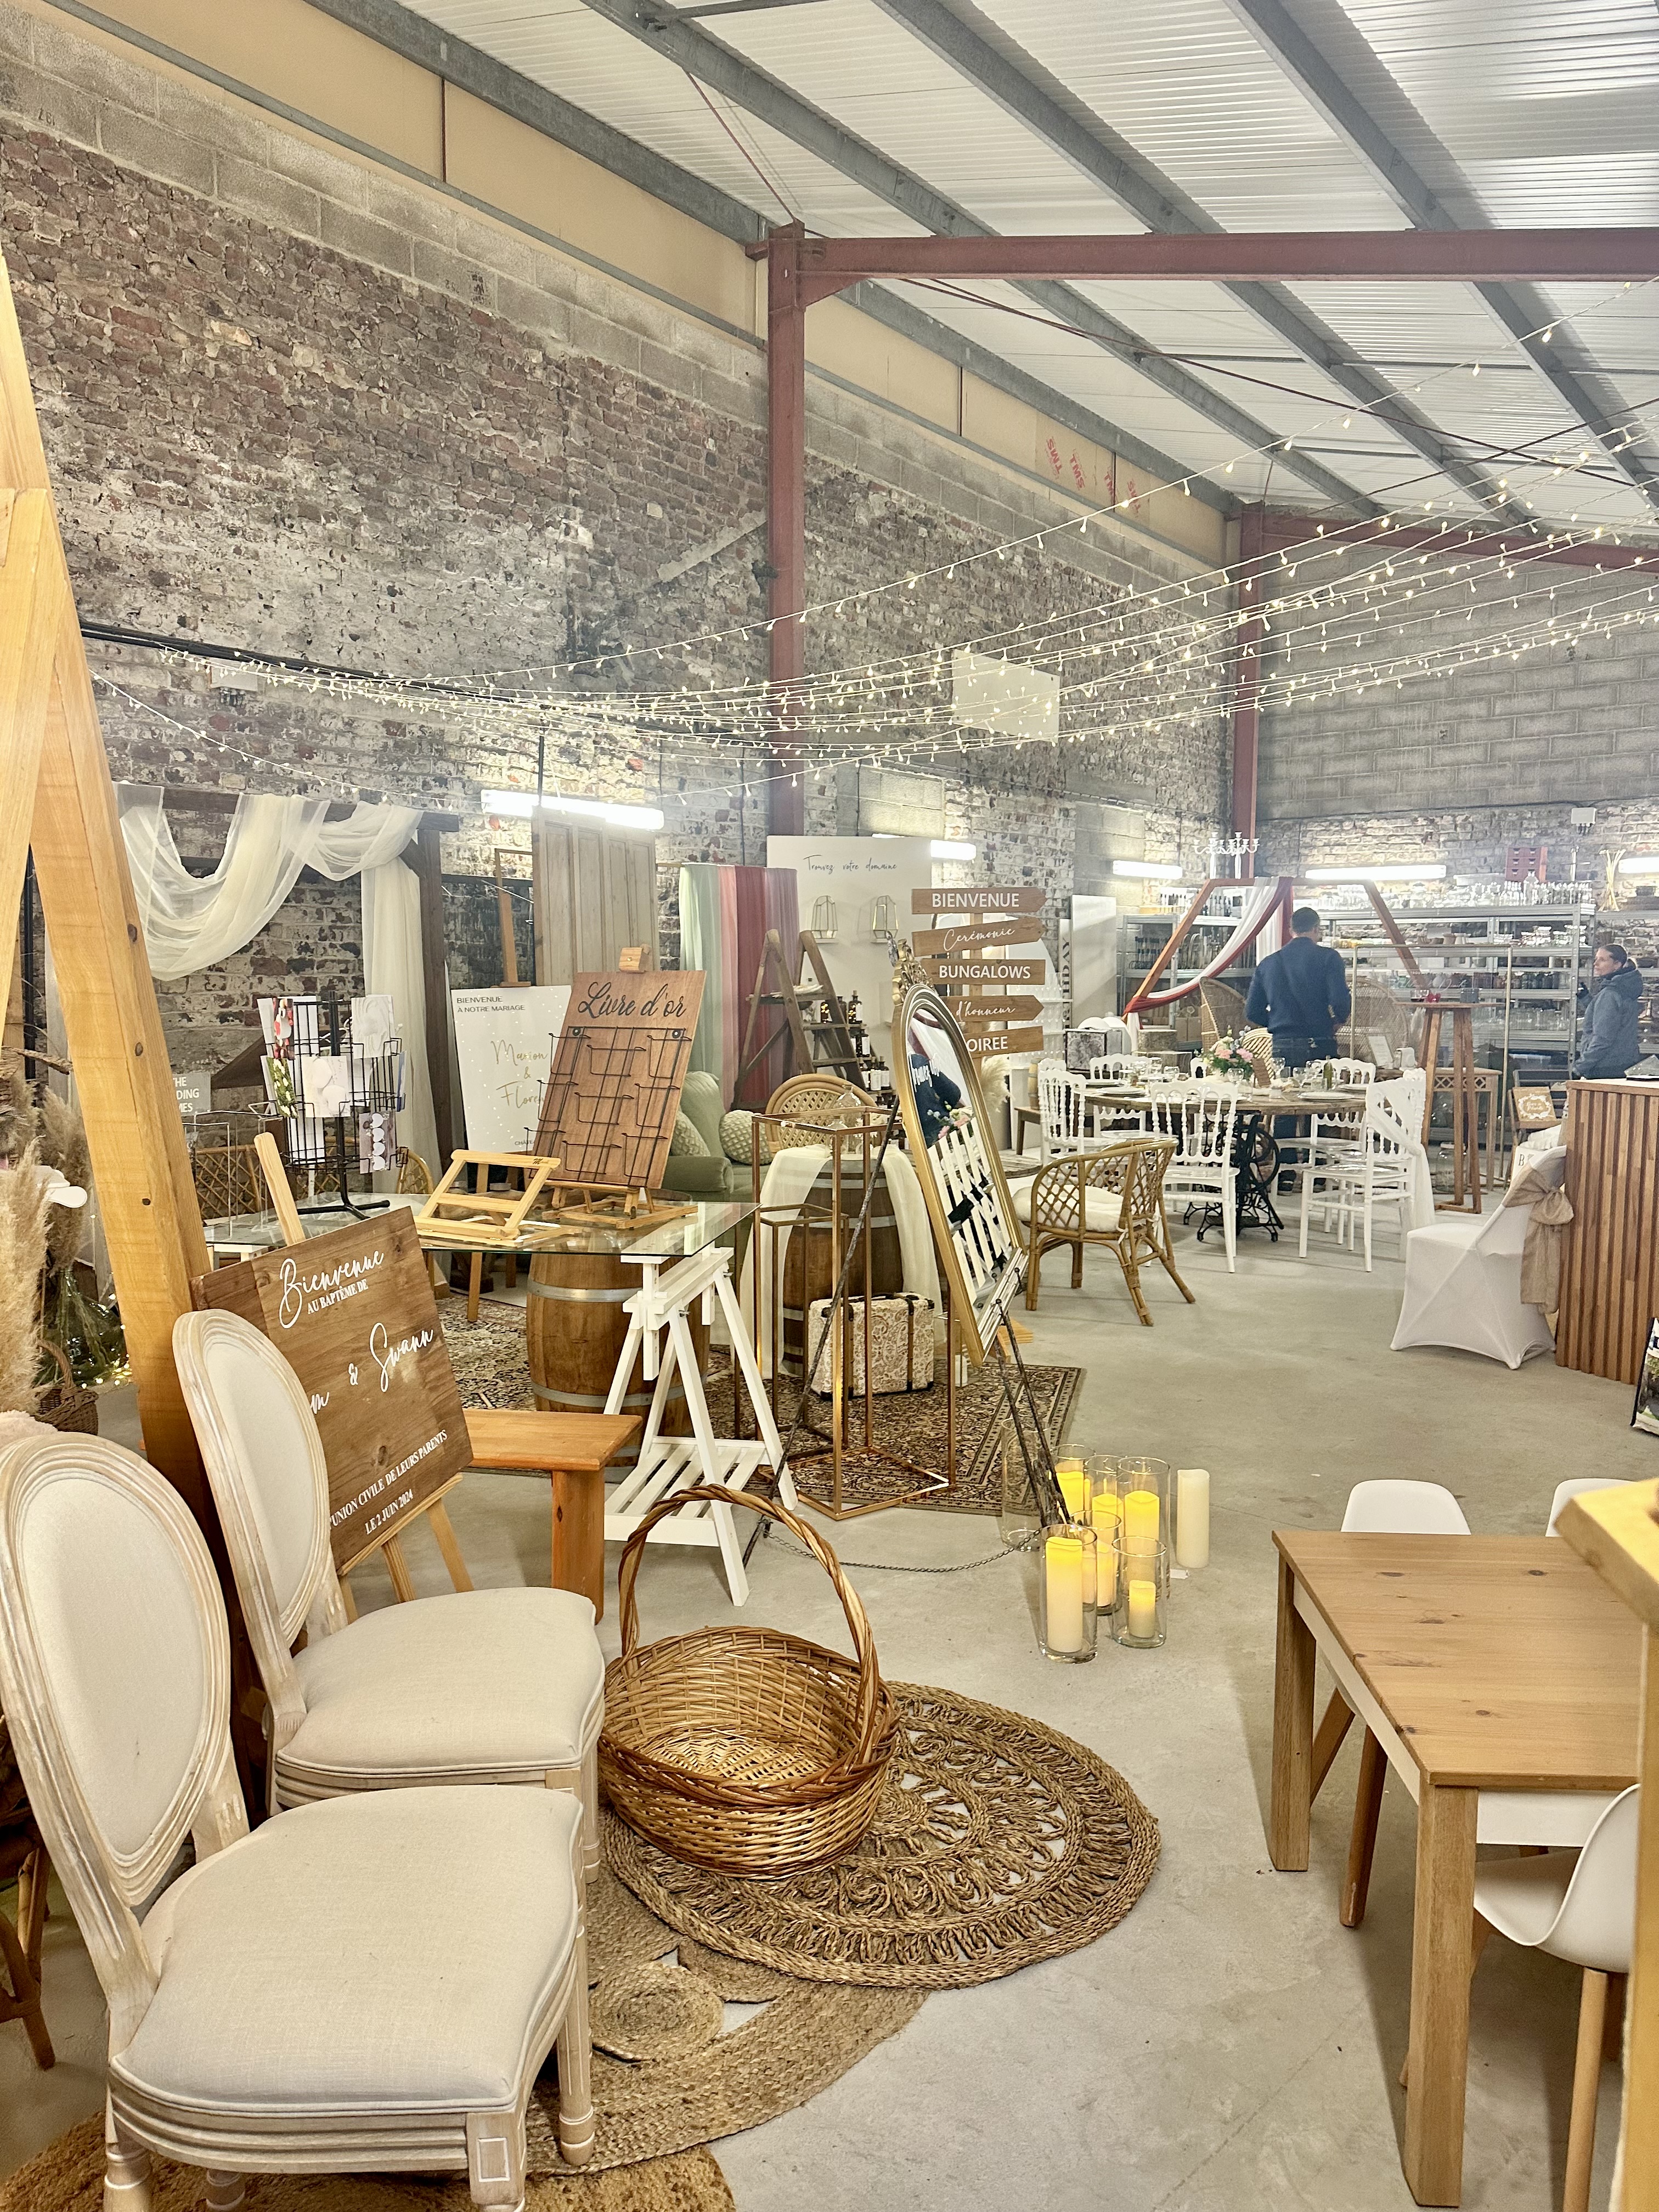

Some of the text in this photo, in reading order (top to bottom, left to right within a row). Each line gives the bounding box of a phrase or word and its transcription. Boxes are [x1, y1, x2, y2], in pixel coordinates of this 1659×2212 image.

[1047, 438, 1062, 474] TMS
[1070, 454, 1085, 488] TMS
[803, 854, 897, 874] Trouvez votre domaine
[932, 893, 1019, 907] BIENVENUE
[939, 965, 1031, 979] BUNGALOWS
[578, 981, 687, 1019] Livre d'or
[956, 1001, 1016, 1022] d'honneur
[966, 1036, 1008, 1052] OIREE
[524, 1066, 531, 1079] &
[176, 1088, 200, 1100] DING
[279, 1250, 384, 1329] Bienvenue
[307, 1279, 369, 1314] AU BAPTÊME DE
[348, 1363, 358, 1385] &
[370, 1322, 433, 1392] Swann
[330, 1430, 447, 1527] 'UNION CIVILE DE LEURS PARENTS
[364, 1488, 414, 1535] LE 2 JUIN 2024
